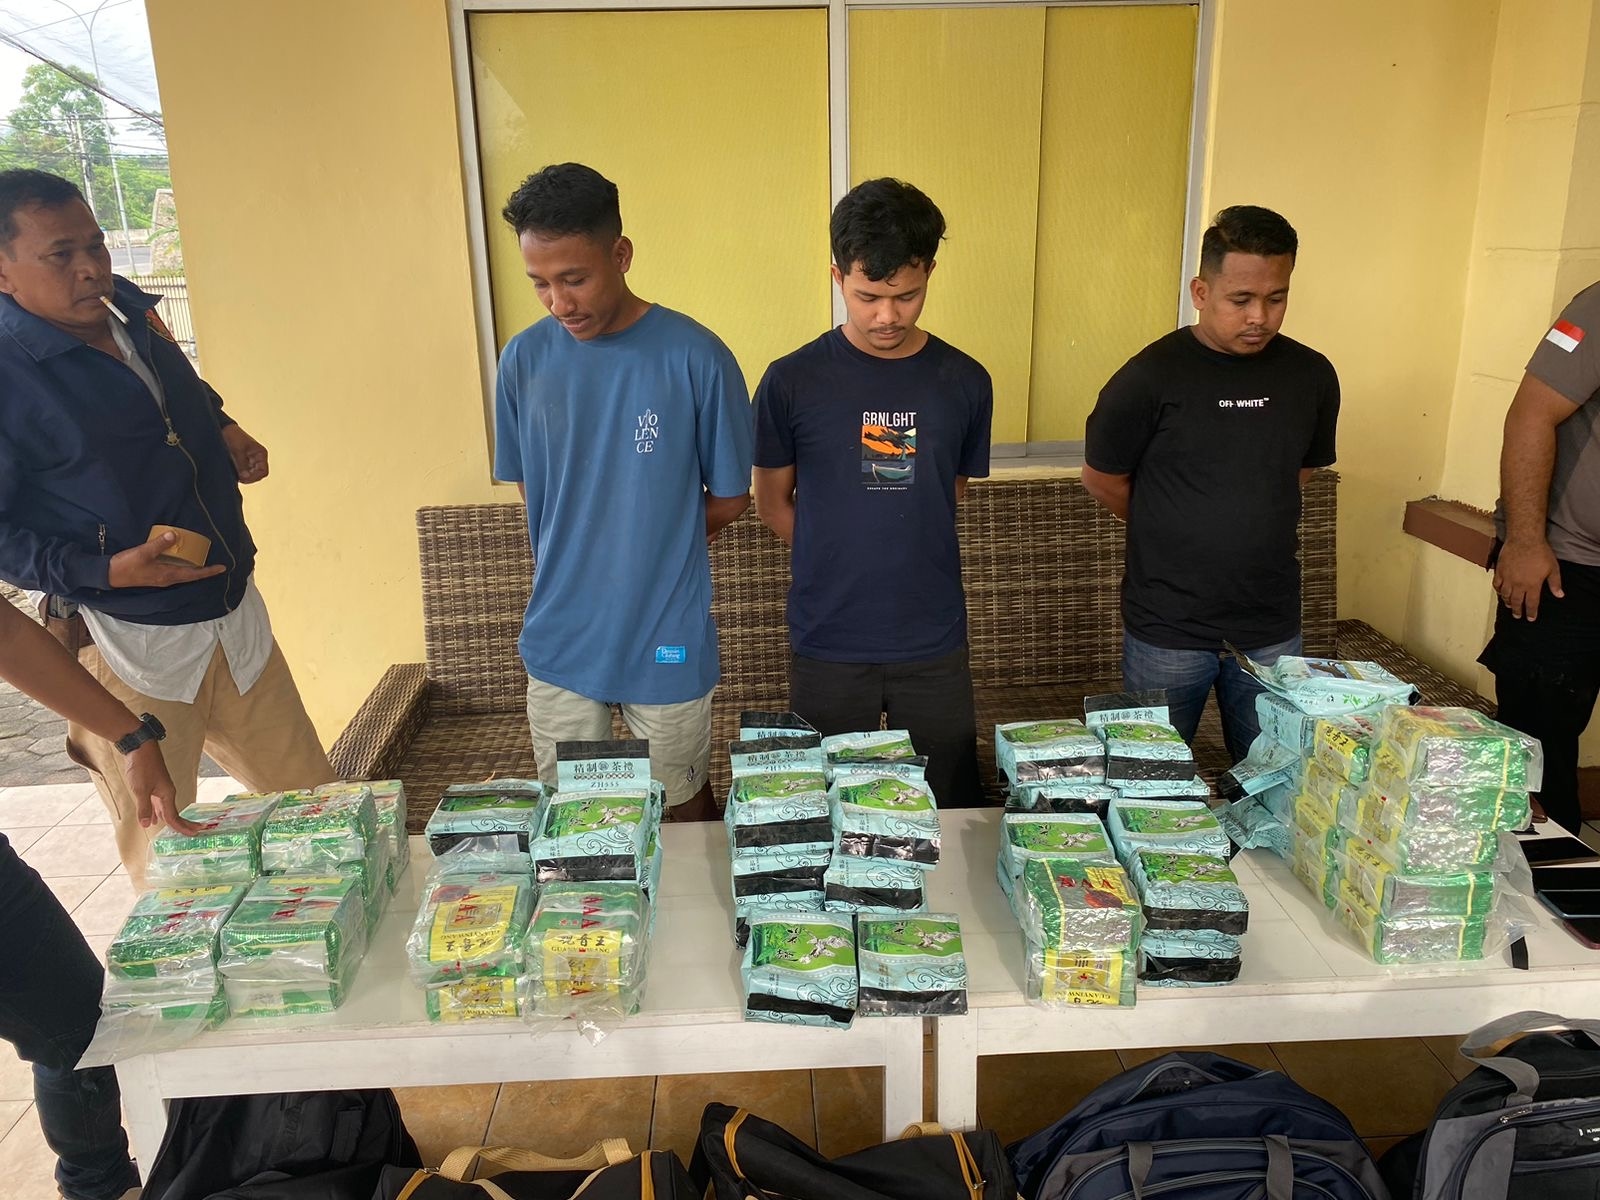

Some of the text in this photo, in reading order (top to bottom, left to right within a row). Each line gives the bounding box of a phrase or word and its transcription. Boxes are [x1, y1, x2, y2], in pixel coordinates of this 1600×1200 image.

[862, 411, 917, 427] GRNLGHT
[634, 427, 659, 441] LEN
[636, 440, 654, 453] CE
